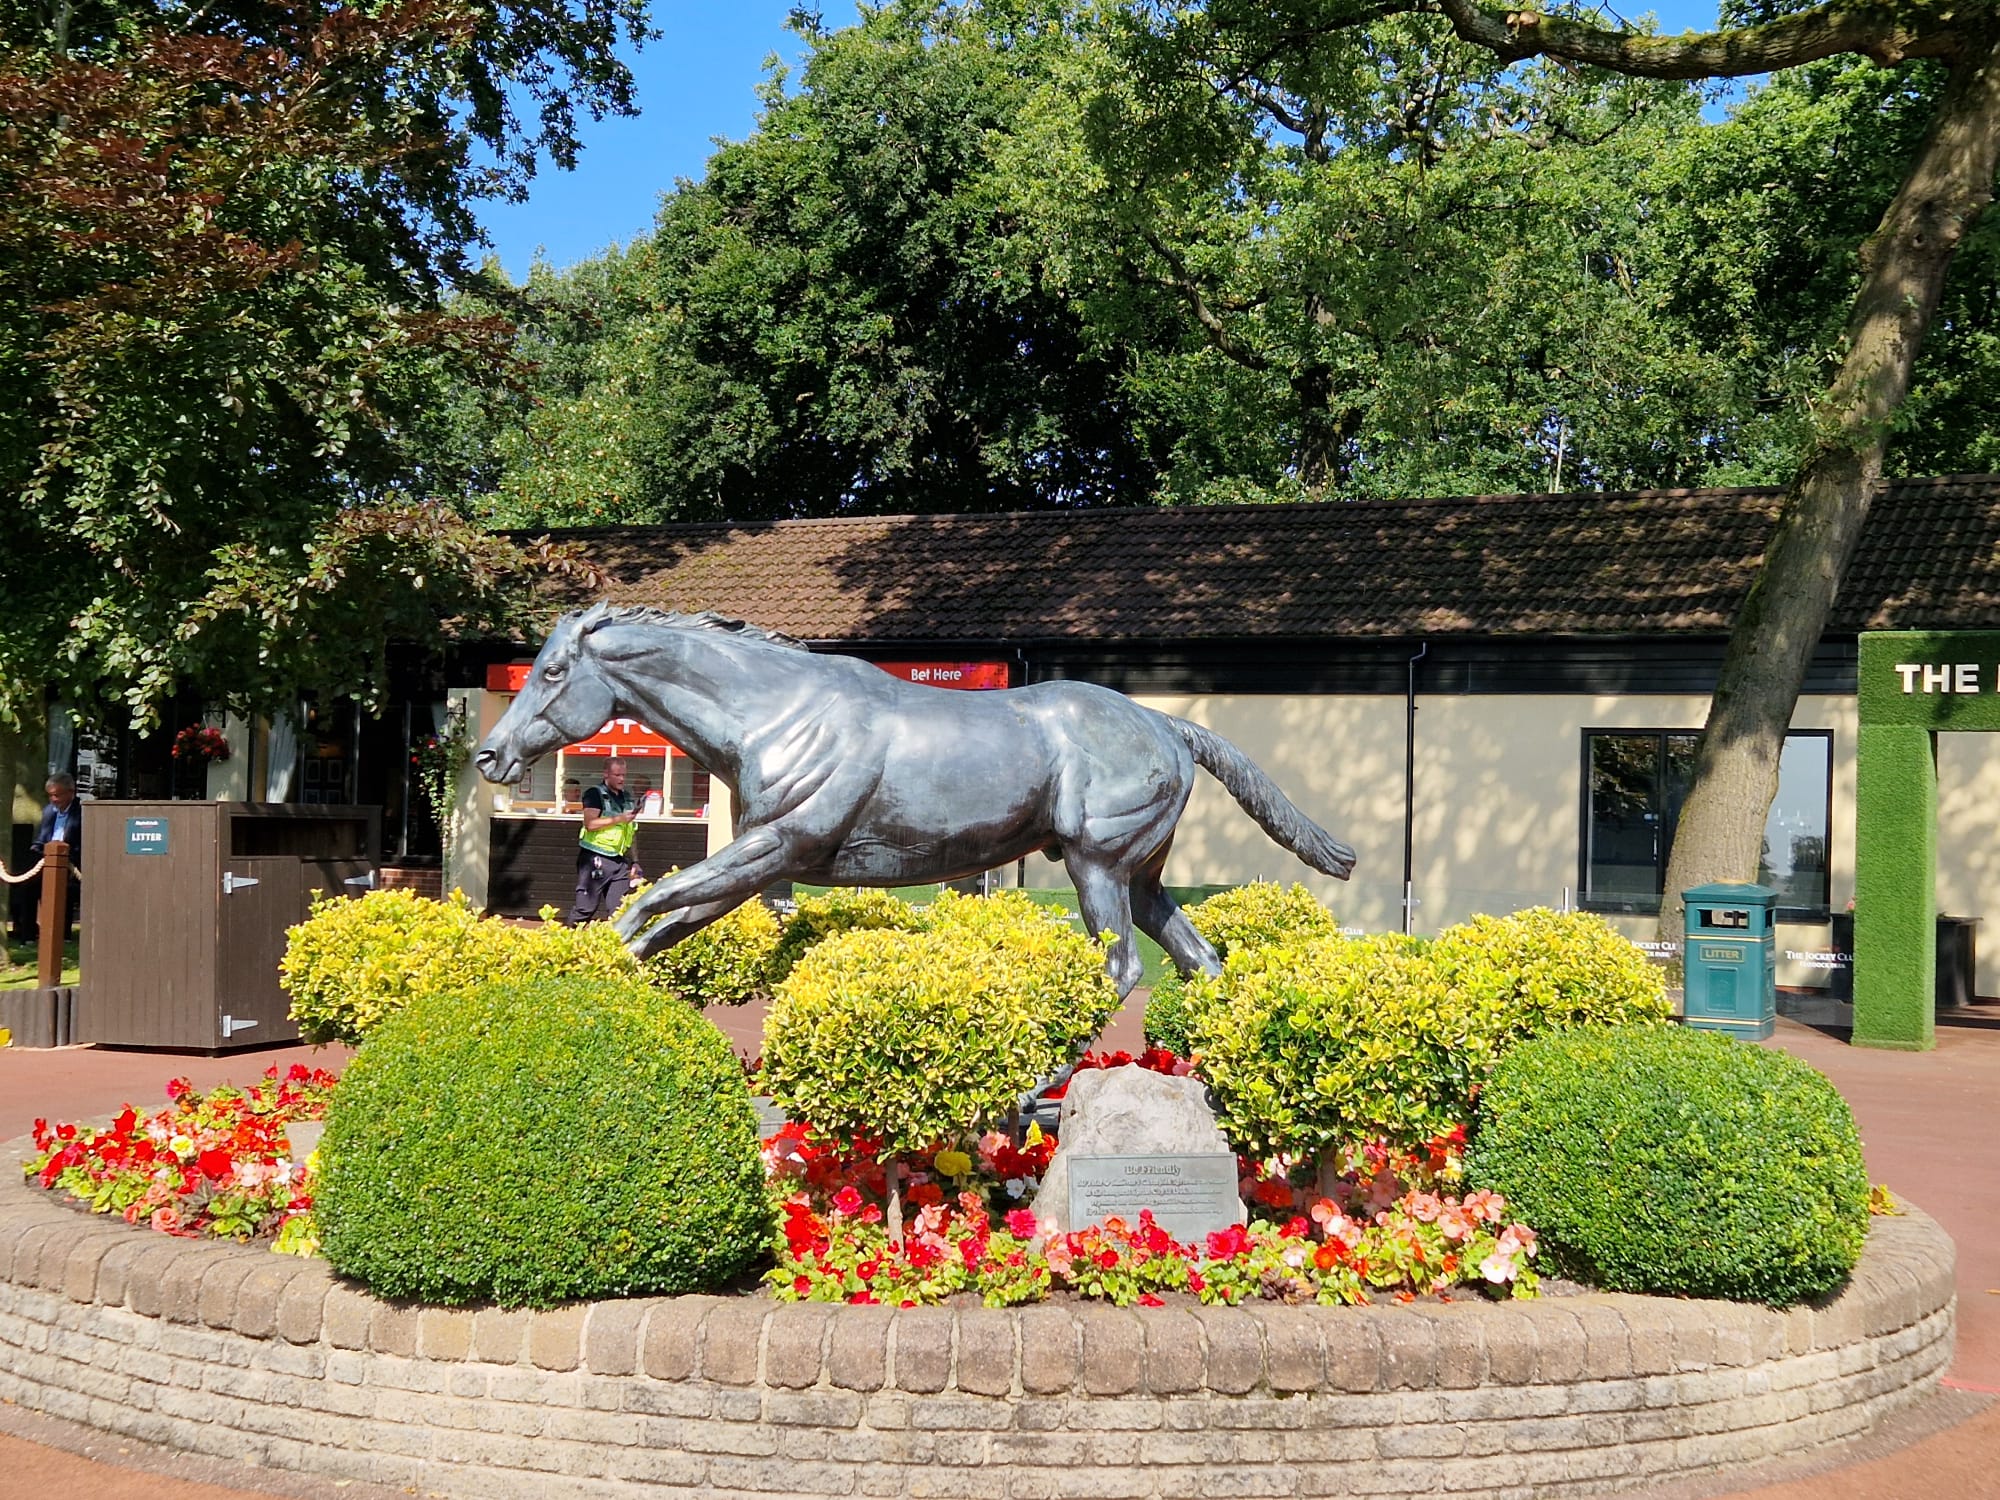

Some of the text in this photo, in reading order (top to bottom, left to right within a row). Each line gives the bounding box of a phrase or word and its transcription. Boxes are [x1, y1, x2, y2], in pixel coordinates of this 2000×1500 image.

[911, 669, 962, 681] Bet Here
[1895, 664, 1980, 693] THE
[131, 833, 162, 842] LITTER
[1705, 949, 1740, 959] LITTER
[1784, 950, 1855, 962] THE JOCKEY CLU
[1140, 1163, 1181, 1177] Friendly
